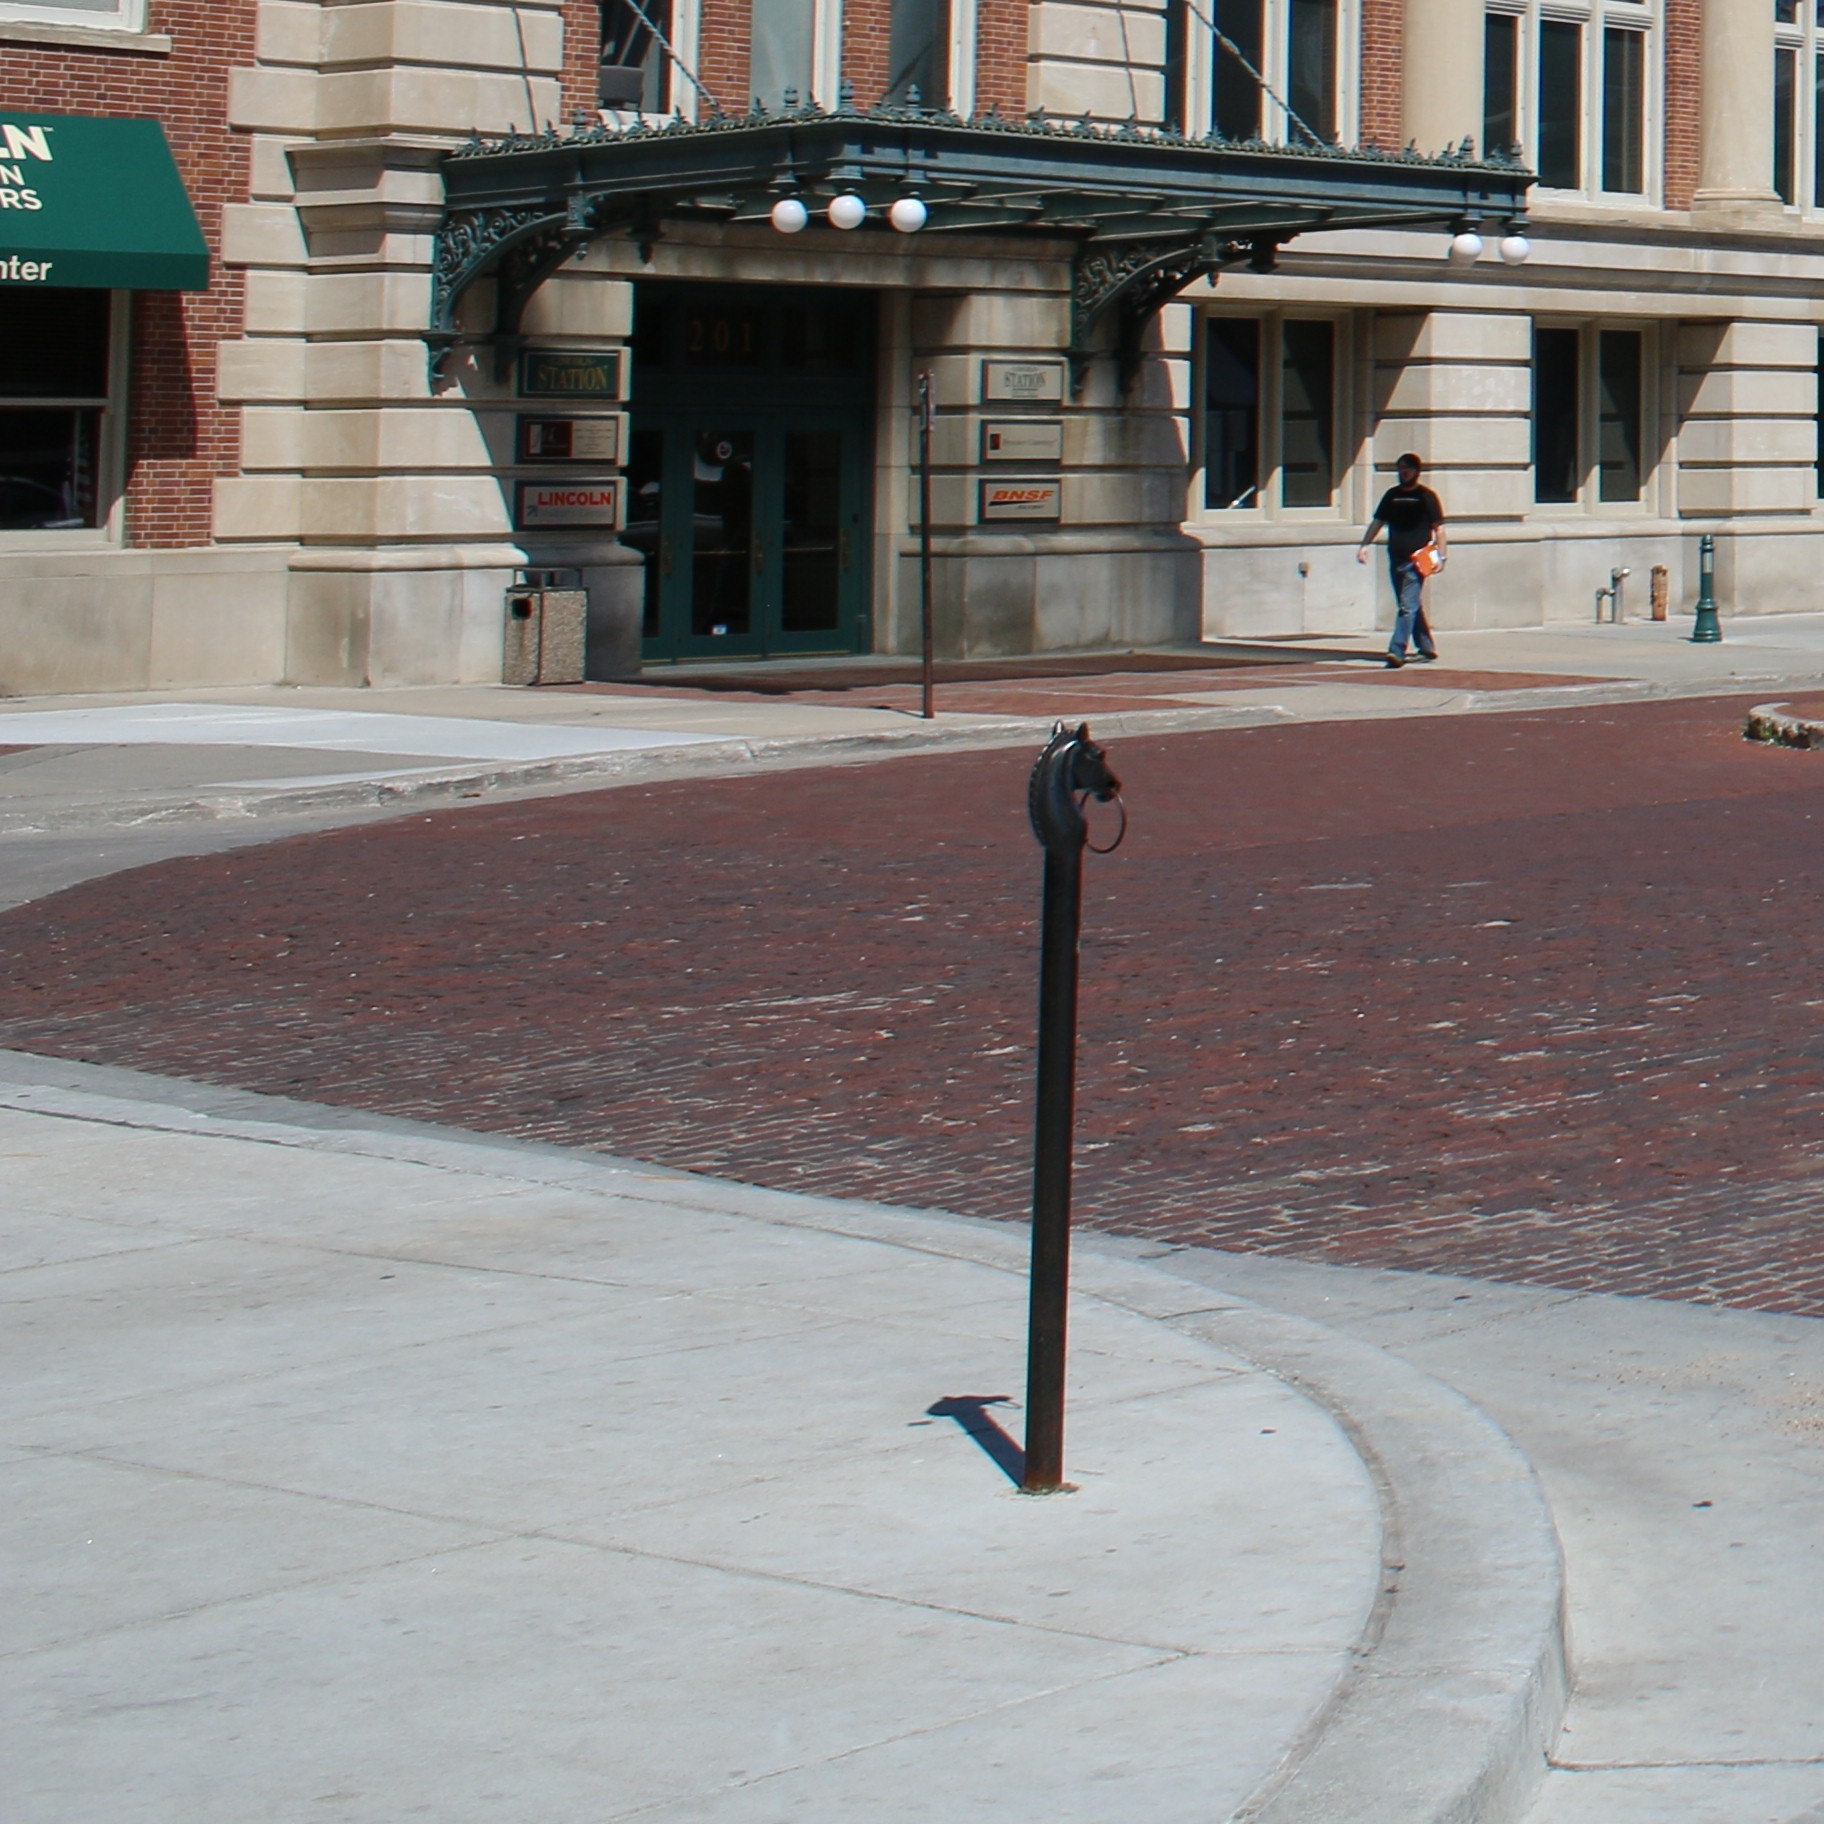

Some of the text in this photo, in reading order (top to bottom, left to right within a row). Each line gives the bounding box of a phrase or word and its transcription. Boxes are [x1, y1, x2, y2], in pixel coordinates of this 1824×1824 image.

[537, 364, 608, 390] STATION
[537, 492, 611, 505] LINCOLN
[992, 490, 1054, 501] BNSF
